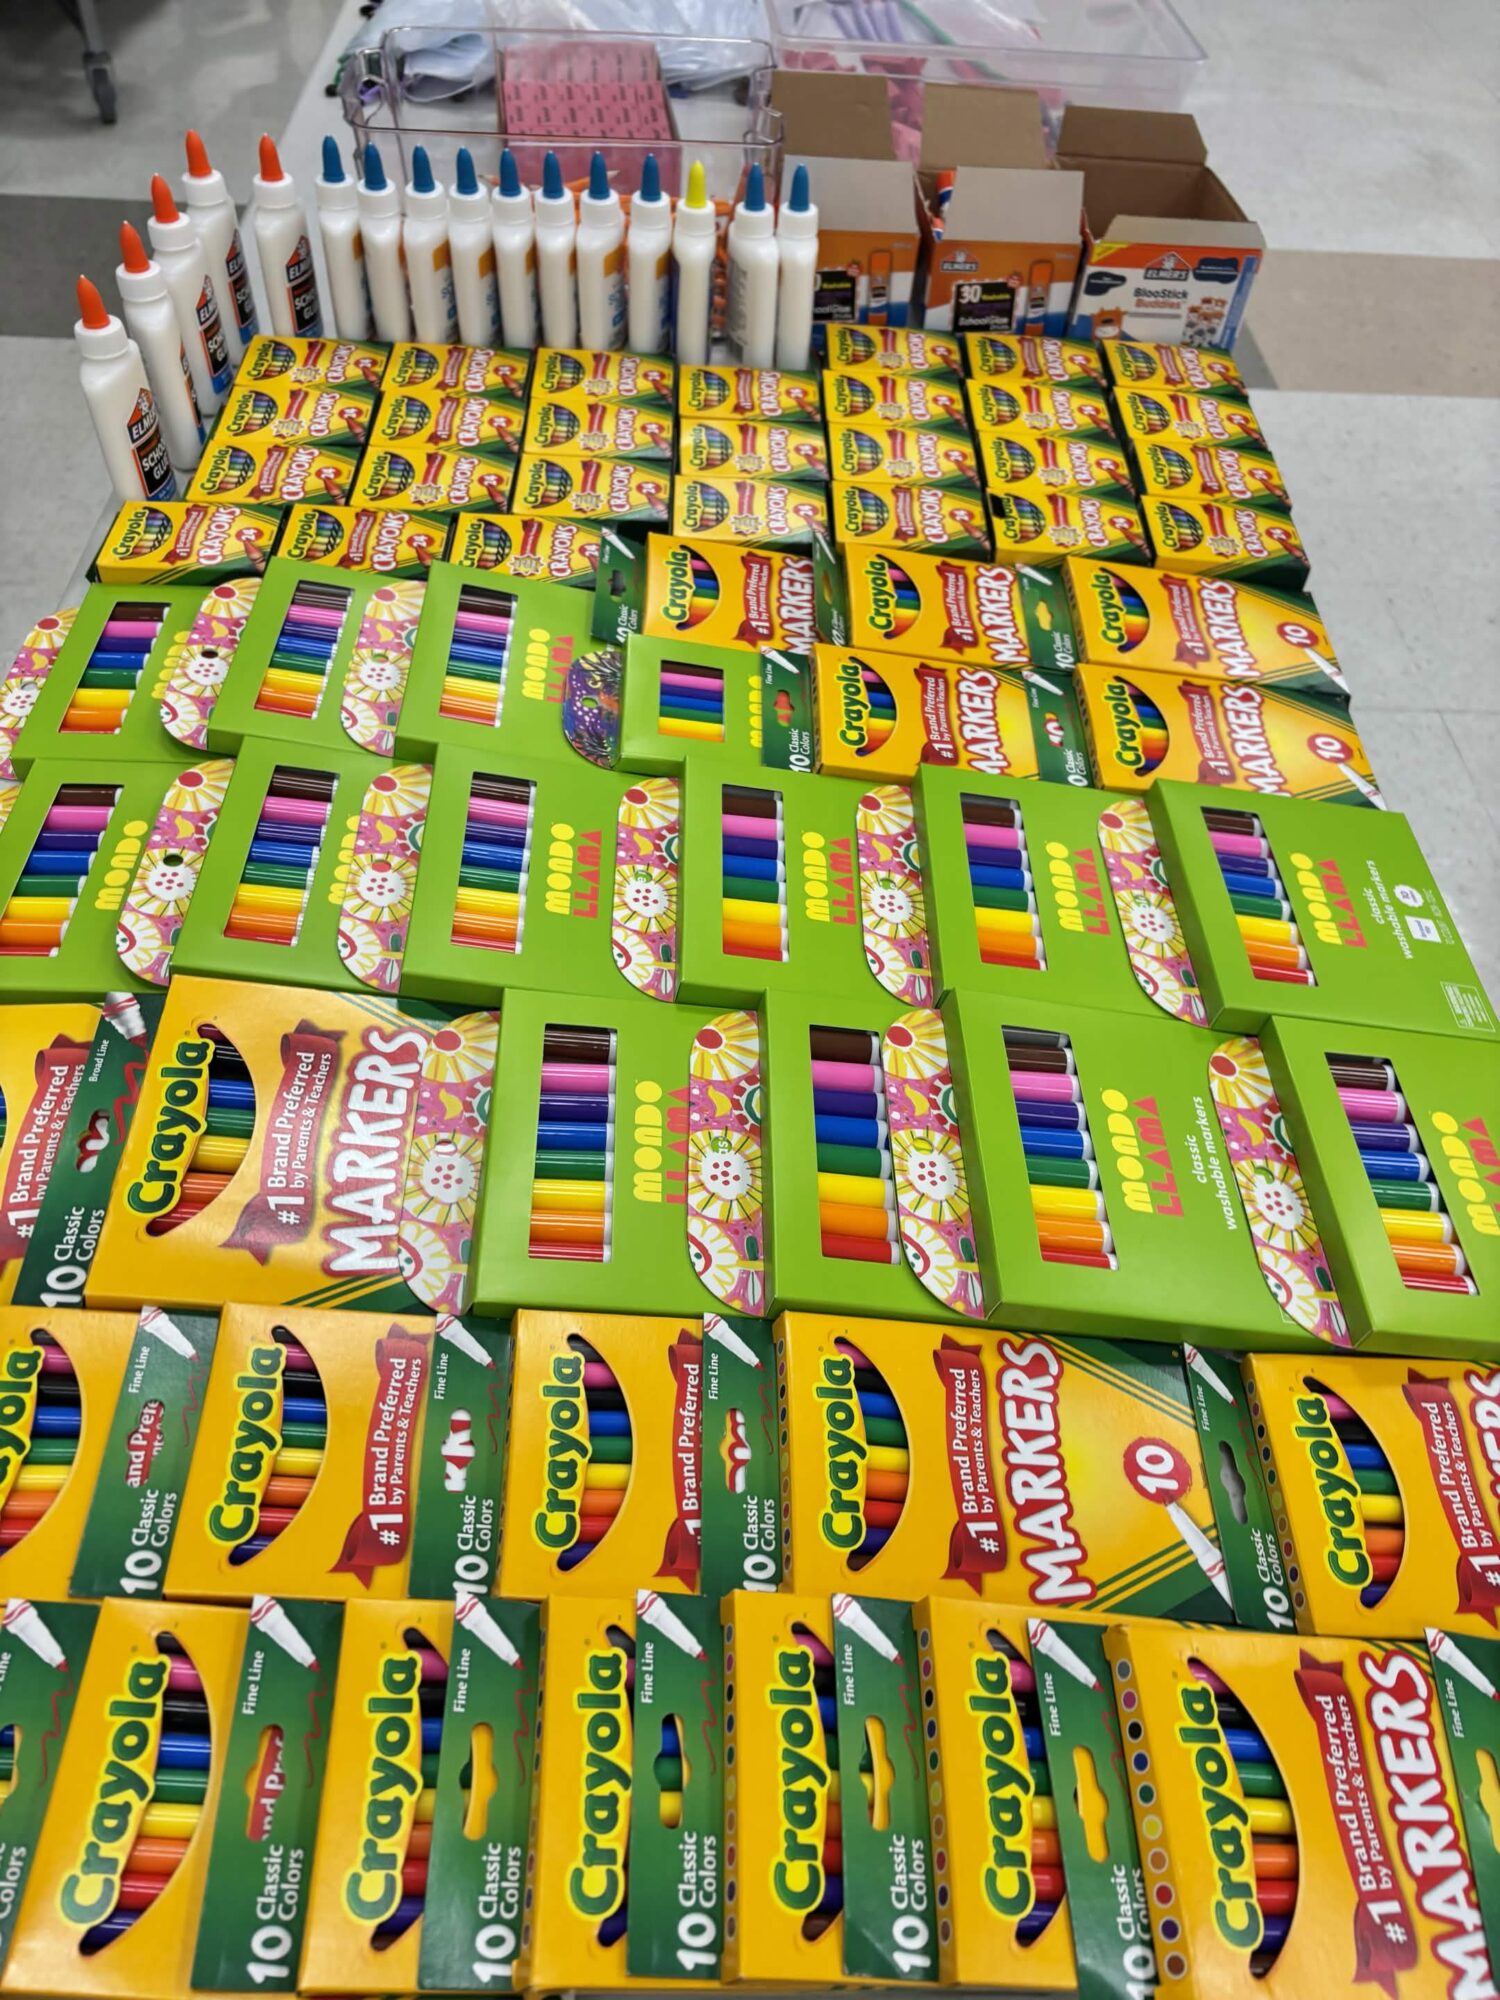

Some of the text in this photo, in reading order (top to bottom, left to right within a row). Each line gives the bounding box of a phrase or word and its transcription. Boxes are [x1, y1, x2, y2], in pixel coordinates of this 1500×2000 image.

[960, 285, 981, 304] 30
[620, 357, 640, 396] CRAYONS
[909, 333, 928, 369] CRAYONS
[1180, 348, 1210, 389] CRAYONS
[311, 392, 339, 436] CRAYONS
[760, 371, 781, 416] CRAYONS
[1054, 391, 1076, 430] CRAYONS
[1201, 400, 1228, 439] CRAYONS
[533, 404, 552, 446] Crayola
[615, 409, 637, 450] CRAYONS
[841, 430, 856, 472] Crayola
[361, 453, 388, 497] Crayola
[450, 458, 479, 504] CRAYONS
[918, 434, 940, 478] CRAYONS
[1069, 443, 1095, 486] CRAYONS
[1146, 446, 1168, 488] Crayola
[1218, 450, 1250, 499] CRAYONS
[681, 483, 700, 531] Crayola
[768, 486, 789, 535] CRAYONS
[843, 488, 860, 532] Crayola
[919, 489, 948, 543] CRAYONS
[1159, 505, 1177, 551] Crayola
[199, 507, 241, 564] CRAYONS
[286, 511, 316, 558] Crayola
[551, 525, 577, 577] CRAYONS
[585, 544, 599, 556] 24
[1236, 510, 1267, 558] CRAYONS
[746, 563, 760, 595] Preferred
[866, 561, 896, 632] Crayola
[746, 595, 759, 619] Brand
[779, 557, 818, 655] MARKERS
[977, 567, 1029, 662] MARKERS
[1200, 580, 1261, 677] MARKERS
[1284, 624, 1308, 645] 10
[834, 662, 870, 748] Crayola
[923, 676, 935, 713] Preferred
[925, 713, 941, 741] Brand
[1105, 683, 1144, 768] Crayola
[1317, 736, 1341, 758] 10
[1068, 774, 1088, 787] 0
[1363, 887, 1385, 924] classic
[1366, 860, 1413, 959] washable markers
[89, 1039, 109, 1082] Broad Line
[306, 1052, 331, 1102] Teachers
[8, 1066, 69, 1238] #1 Brand Preferred
[268, 1051, 315, 1225] #1 Brand Preferred
[295, 1117, 313, 1168] Parents
[329, 1031, 427, 1274] MARKERS
[1185, 1134, 1207, 1184] classic
[1193, 1096, 1237, 1230] washable markers
[292, 1172, 306, 1189] by
[54, 1206, 85, 1262] Classic
[75, 1209, 105, 1262] Colors
[40, 1265, 87, 1308] 10
[128, 1346, 150, 1393] Fine Line
[399, 1358, 422, 1415] Teachers
[709, 1353, 719, 1400] Fine Line
[677, 1363, 699, 1447] Preferred
[969, 1369, 981, 1426] Teachers
[211, 1347, 283, 1542] Crayola
[368, 1358, 406, 1546] #1 Brand Preferred
[391, 1429, 408, 1485] Parents
[817, 1357, 866, 1549] Crayola
[976, 1440, 991, 1494] Parents
[1002, 1341, 1094, 1600] MARKERS
[390, 1489, 403, 1505] by
[678, 1453, 699, 1511] Brand
[980, 1497, 994, 1513] by
[1421, 1402, 1500, 1587] #1 Brand Preferred
[457, 1495, 477, 1551] Classic
[475, 1498, 493, 1553] Colors
[120, 1550, 162, 1594] 10
[743, 1554, 776, 1592] 10
[1252, 1528, 1271, 1583] Classic
[1265, 1533, 1285, 1588] Colors
[243, 1651, 265, 1715] Fine Line
[641, 1642, 654, 1704] Fine Line
[1045, 1673, 1062, 1736] Fine Line
[347, 1657, 419, 1922] Crayola
[571, 1652, 632, 1916] Crayola
[774, 1652, 827, 1910] Crayola
[1179, 1686, 1262, 1948] Crayola
[1315, 1695, 1408, 1943] #1 Brand Preferred
[1368, 1652, 1500, 2000] MARKERS
[479, 1842, 502, 1920] Classic
[500, 1846, 522, 1920] Colors
[678, 1831, 697, 1908] Classic
[698, 1835, 717, 1908] Colors
[1112, 1864, 1135, 1940] Classic
[474, 1924, 517, 1984] 10
[677, 1913, 717, 1970] 10
